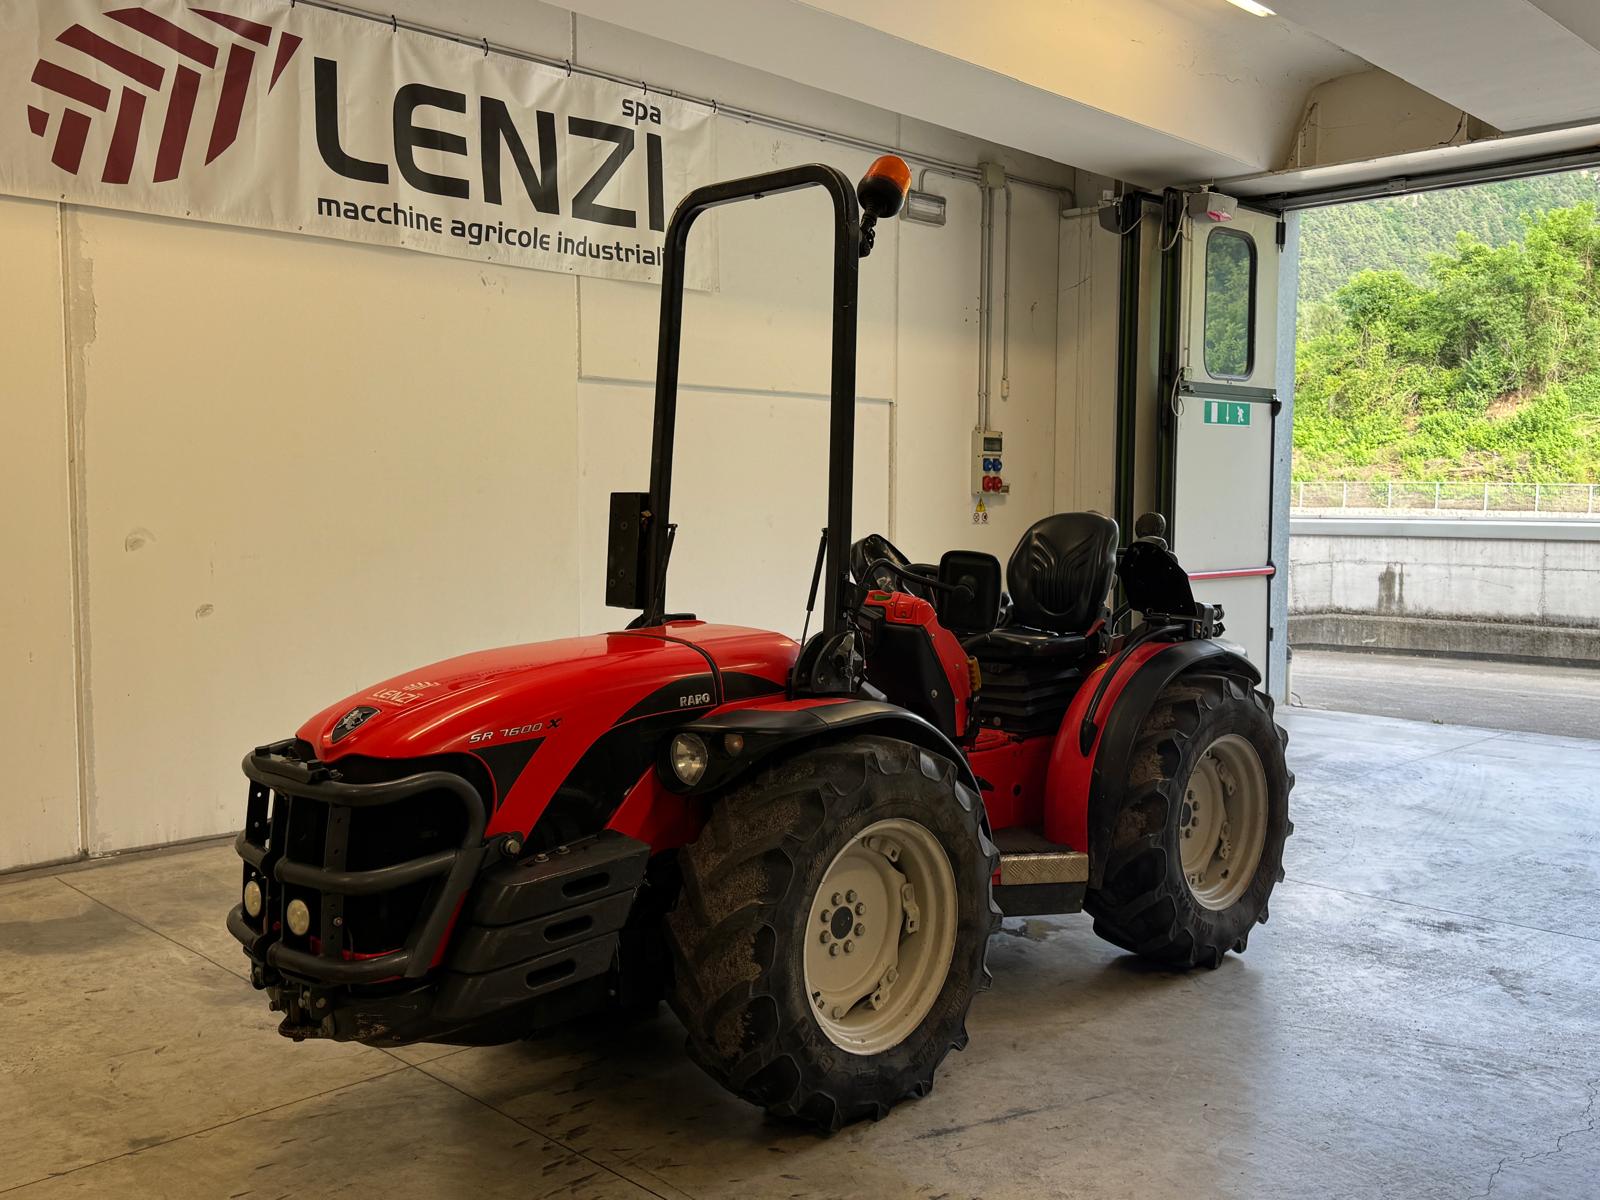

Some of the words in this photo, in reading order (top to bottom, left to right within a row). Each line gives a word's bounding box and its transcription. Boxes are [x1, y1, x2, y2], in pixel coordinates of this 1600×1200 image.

[313, 56, 665, 233] LENZI
[621, 97, 661, 125] spa
[317, 196, 442, 234] macchine
[450, 218, 550, 252] agricole
[372, 688, 421, 704] LENZI
[679, 692, 711, 707] RARO
[469, 731, 494, 744] SR
[499, 722, 544, 737] 7600
